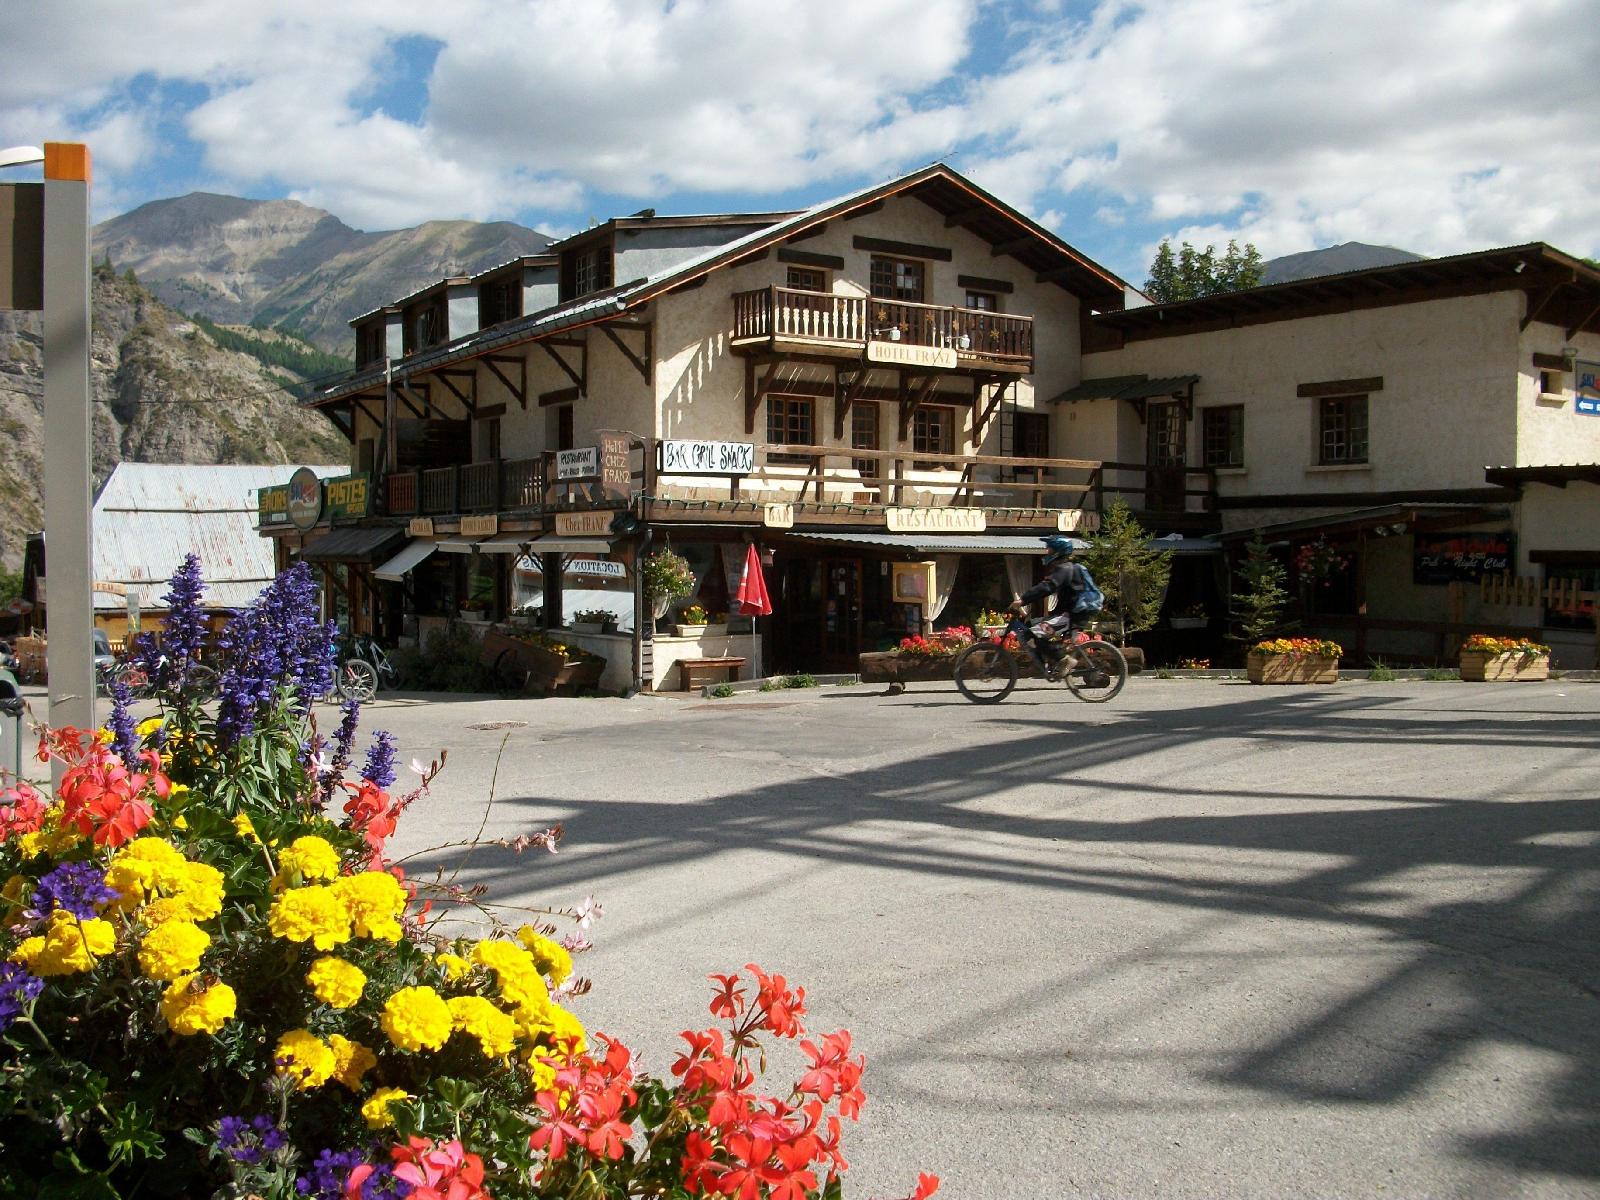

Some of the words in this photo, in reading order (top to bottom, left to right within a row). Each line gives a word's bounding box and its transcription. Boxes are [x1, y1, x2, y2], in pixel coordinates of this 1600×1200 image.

[875, 346, 912, 361] HOTEL
[605, 455, 627, 468] CHEZ
[666, 442, 688, 470] BAR
[692, 443, 716, 470] GRILL
[720, 445, 752, 471] SNACK
[327, 478, 366, 506] PISTES
[768, 508, 790, 523] BAR
[896, 512, 978, 528] RESTAURANT
[1483, 557, 1507, 569] Club
